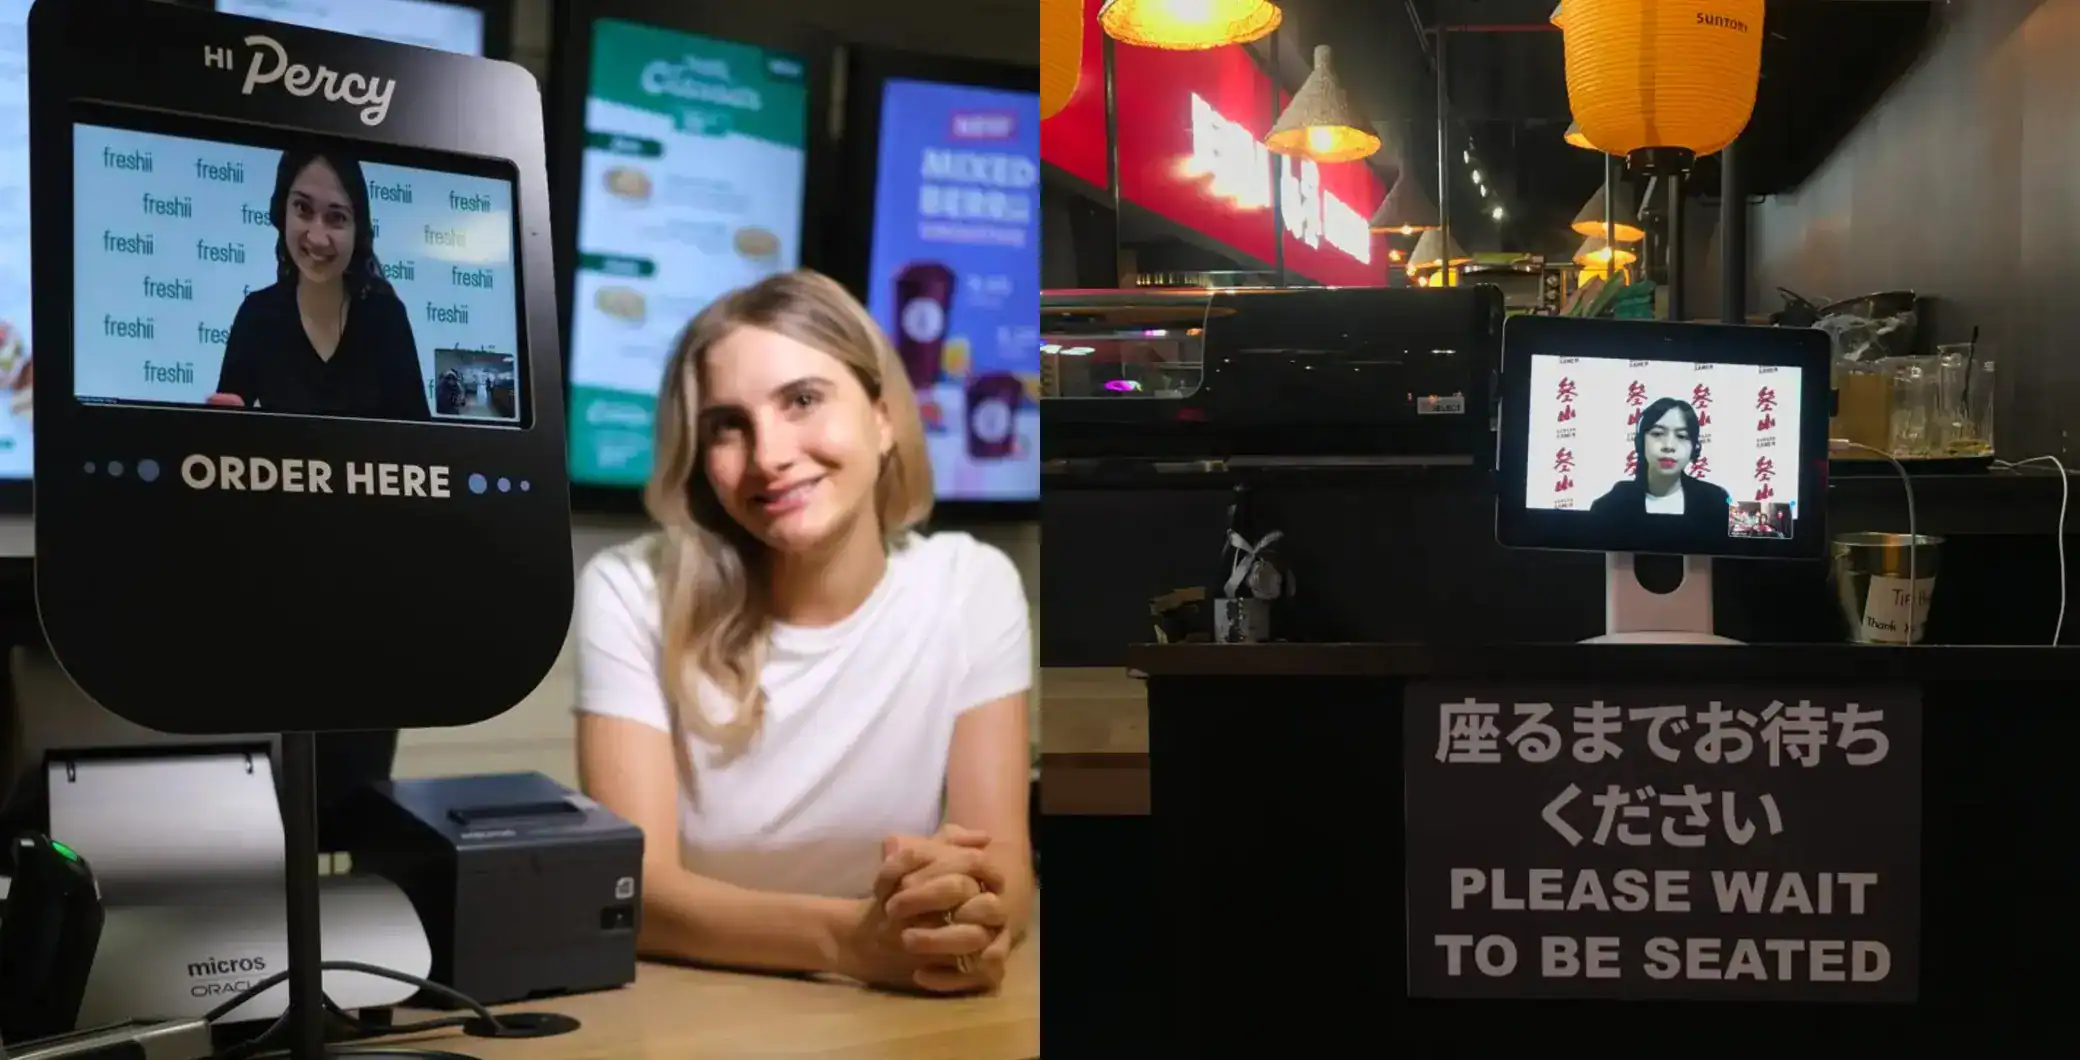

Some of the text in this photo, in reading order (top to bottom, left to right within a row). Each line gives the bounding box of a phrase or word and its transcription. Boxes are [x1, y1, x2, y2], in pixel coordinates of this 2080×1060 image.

[204, 35, 396, 126] HI Percy
[103, 146, 153, 173] freshii
[196, 158, 244, 184] freshii
[369, 181, 412, 204] freshii
[449, 190, 491, 213] freshii
[143, 193, 192, 218] freshii
[241, 203, 271, 226] fres
[103, 230, 154, 255] freshii
[196, 239, 245, 264] freshii
[382, 261, 414, 282] eshii
[452, 266, 493, 288] freshii
[143, 276, 193, 300] freshii
[426, 302, 468, 324] freshii
[104, 314, 154, 339] freshii
[198, 322, 229, 345] fres
[143, 361, 193, 384] freshii
[181, 454, 451, 498] ORDER HERE
[1435, 697, 1890, 768] 座るまでお待ち
[1541, 782, 1783, 847] ください
[1450, 868, 1878, 915] PLEASE WAIT
[187, 956, 266, 977] micros
[1434, 934, 1891, 982] TO BE SEATED
